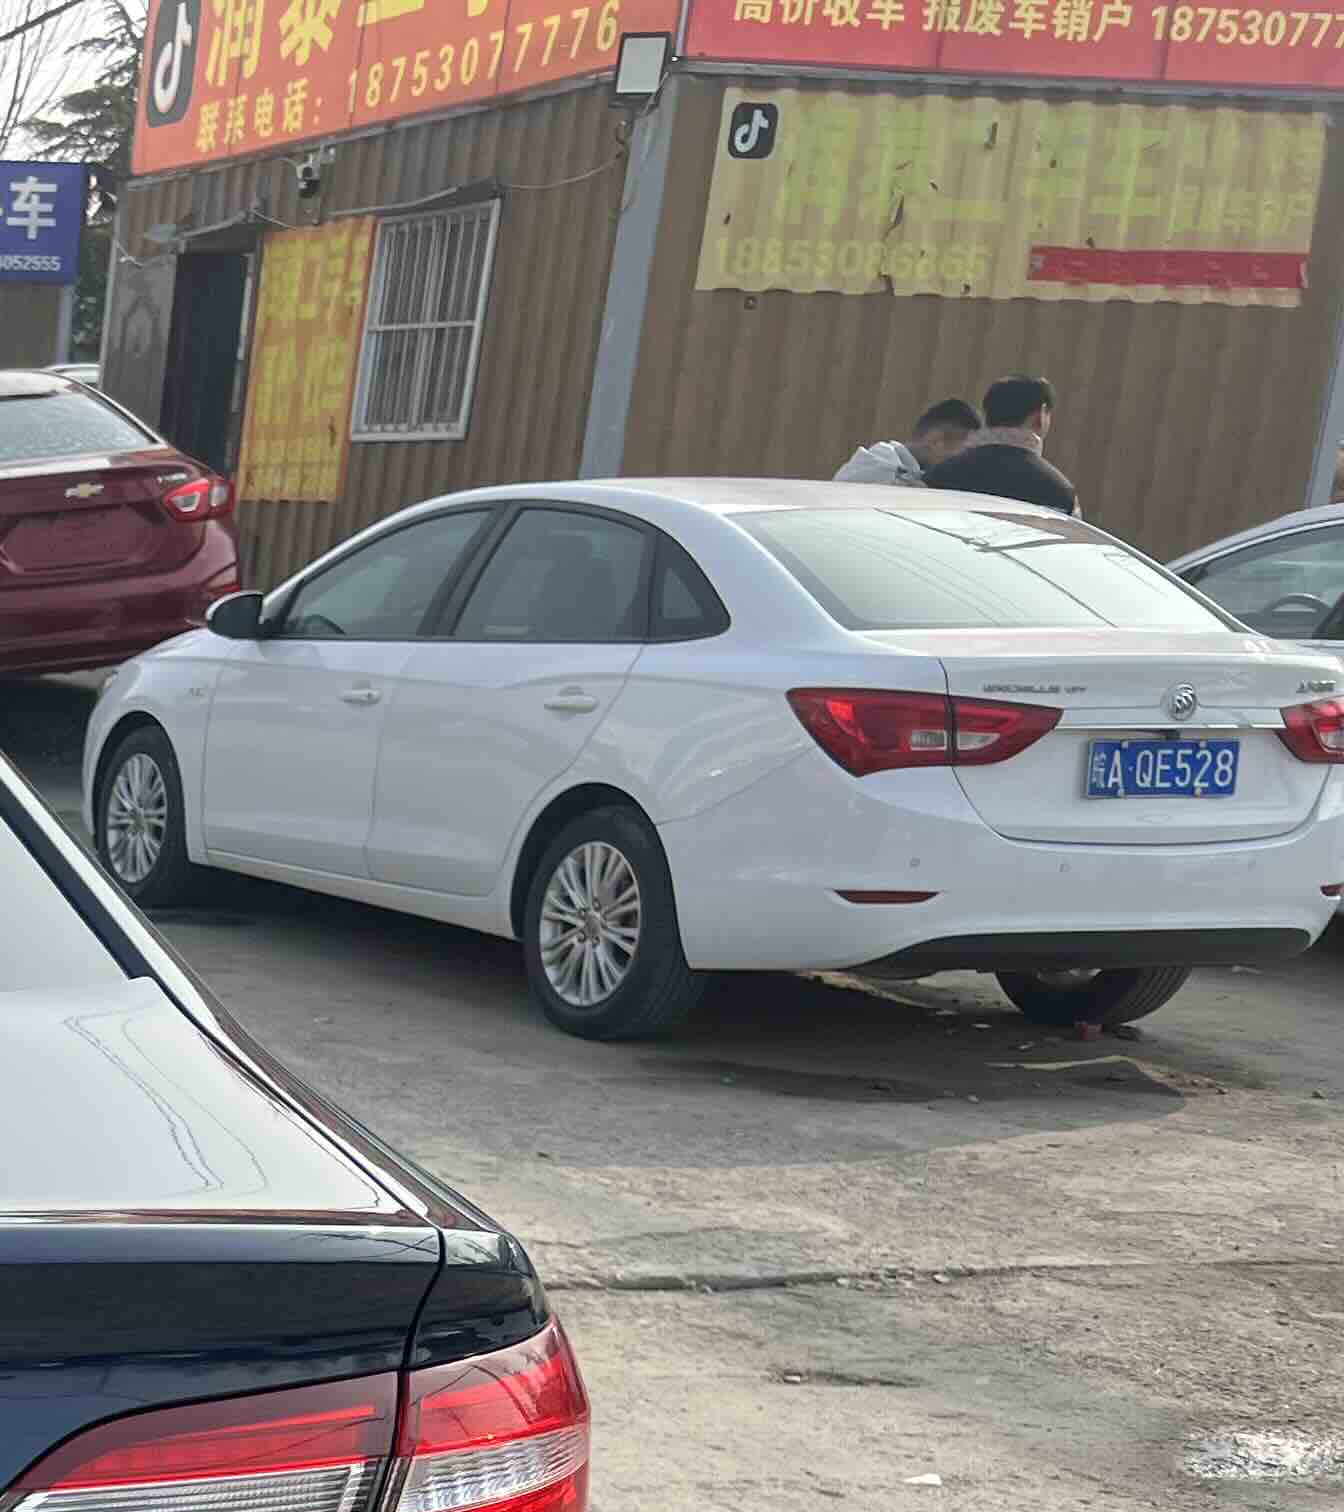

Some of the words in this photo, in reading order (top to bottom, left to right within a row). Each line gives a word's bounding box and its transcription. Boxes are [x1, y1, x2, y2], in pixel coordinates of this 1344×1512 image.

[205, 0, 490, 87] 润泰
[348, 4, 619, 113] 18753077776
[921, 0, 1132, 42] 报废车销户
